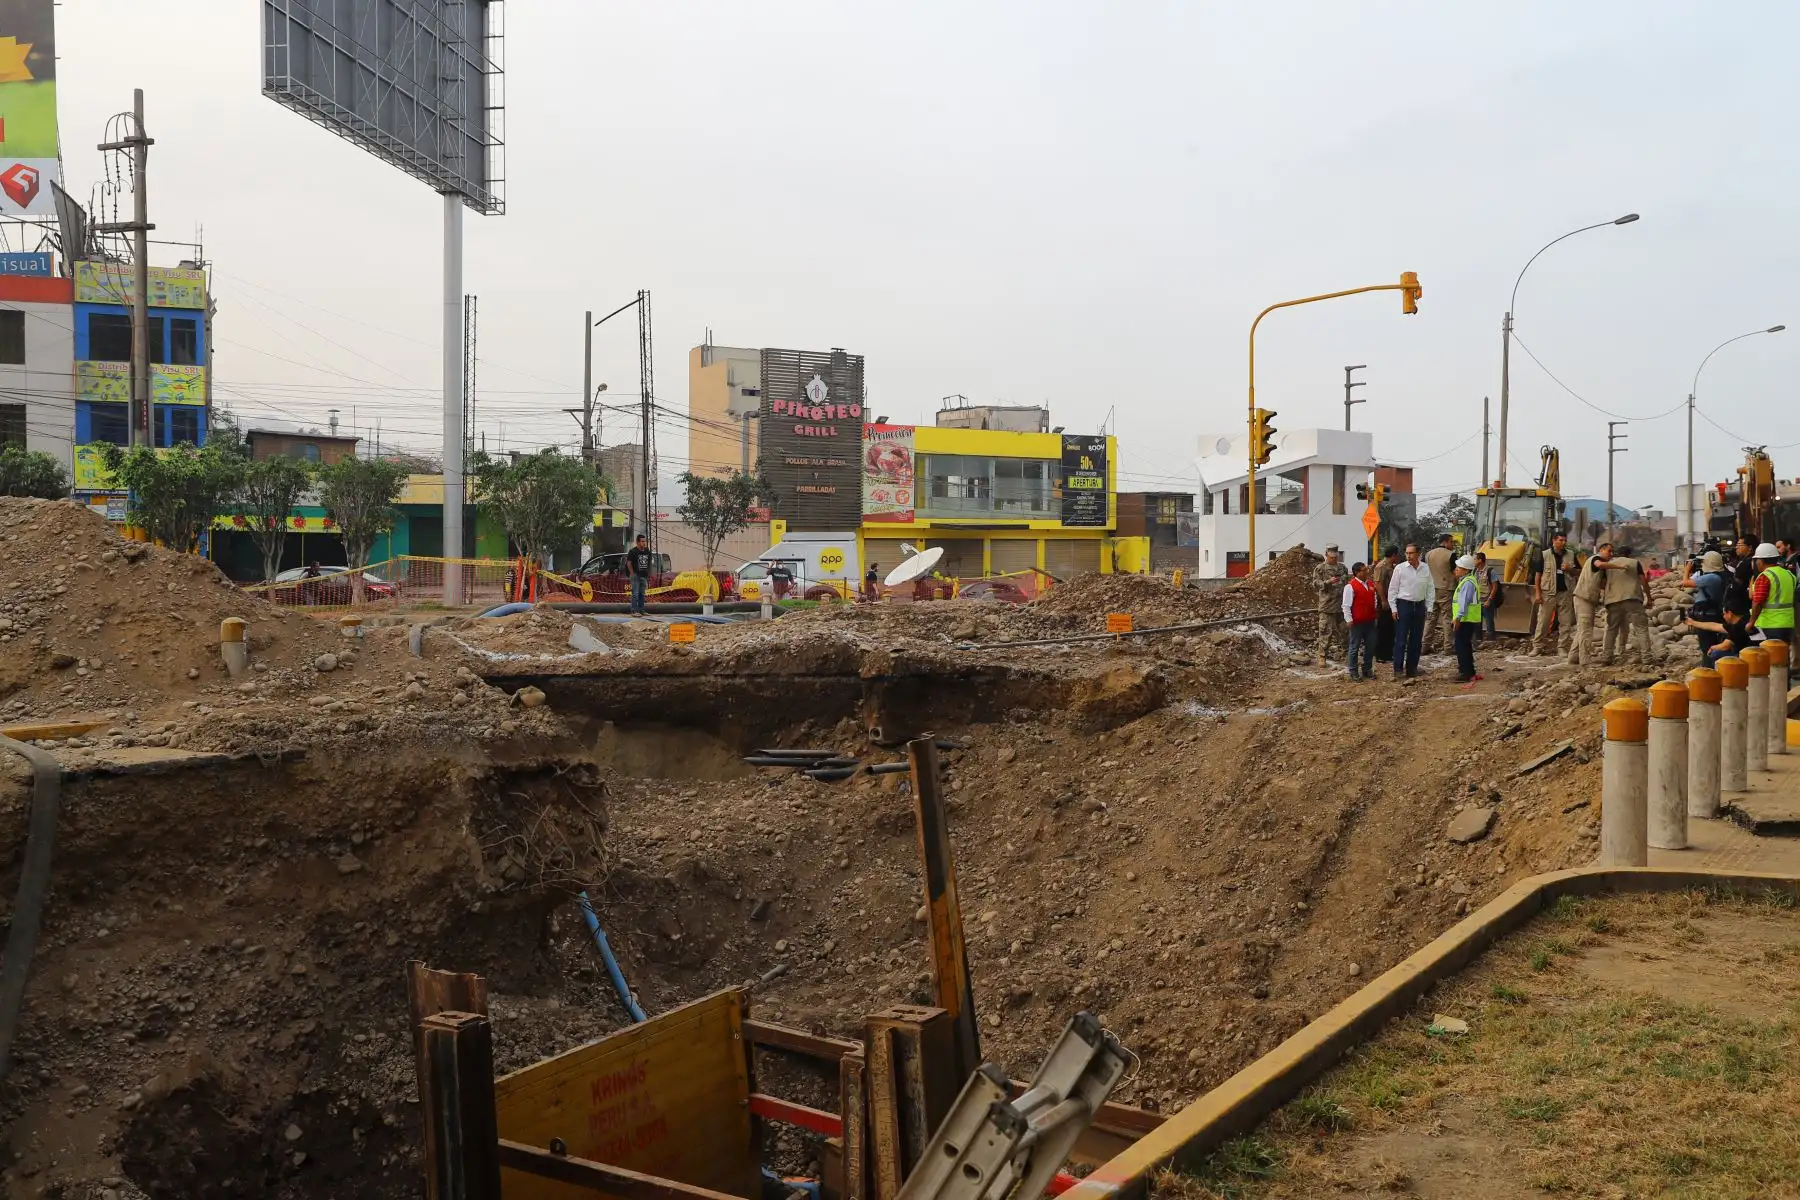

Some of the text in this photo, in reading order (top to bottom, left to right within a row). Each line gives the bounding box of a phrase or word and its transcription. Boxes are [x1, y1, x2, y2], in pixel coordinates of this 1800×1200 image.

[794, 424, 838, 436] GRILL
[814, 472, 819, 480] Y
[1072, 478, 1099, 488] APERTURA
[821, 555, 842, 564] RPP
